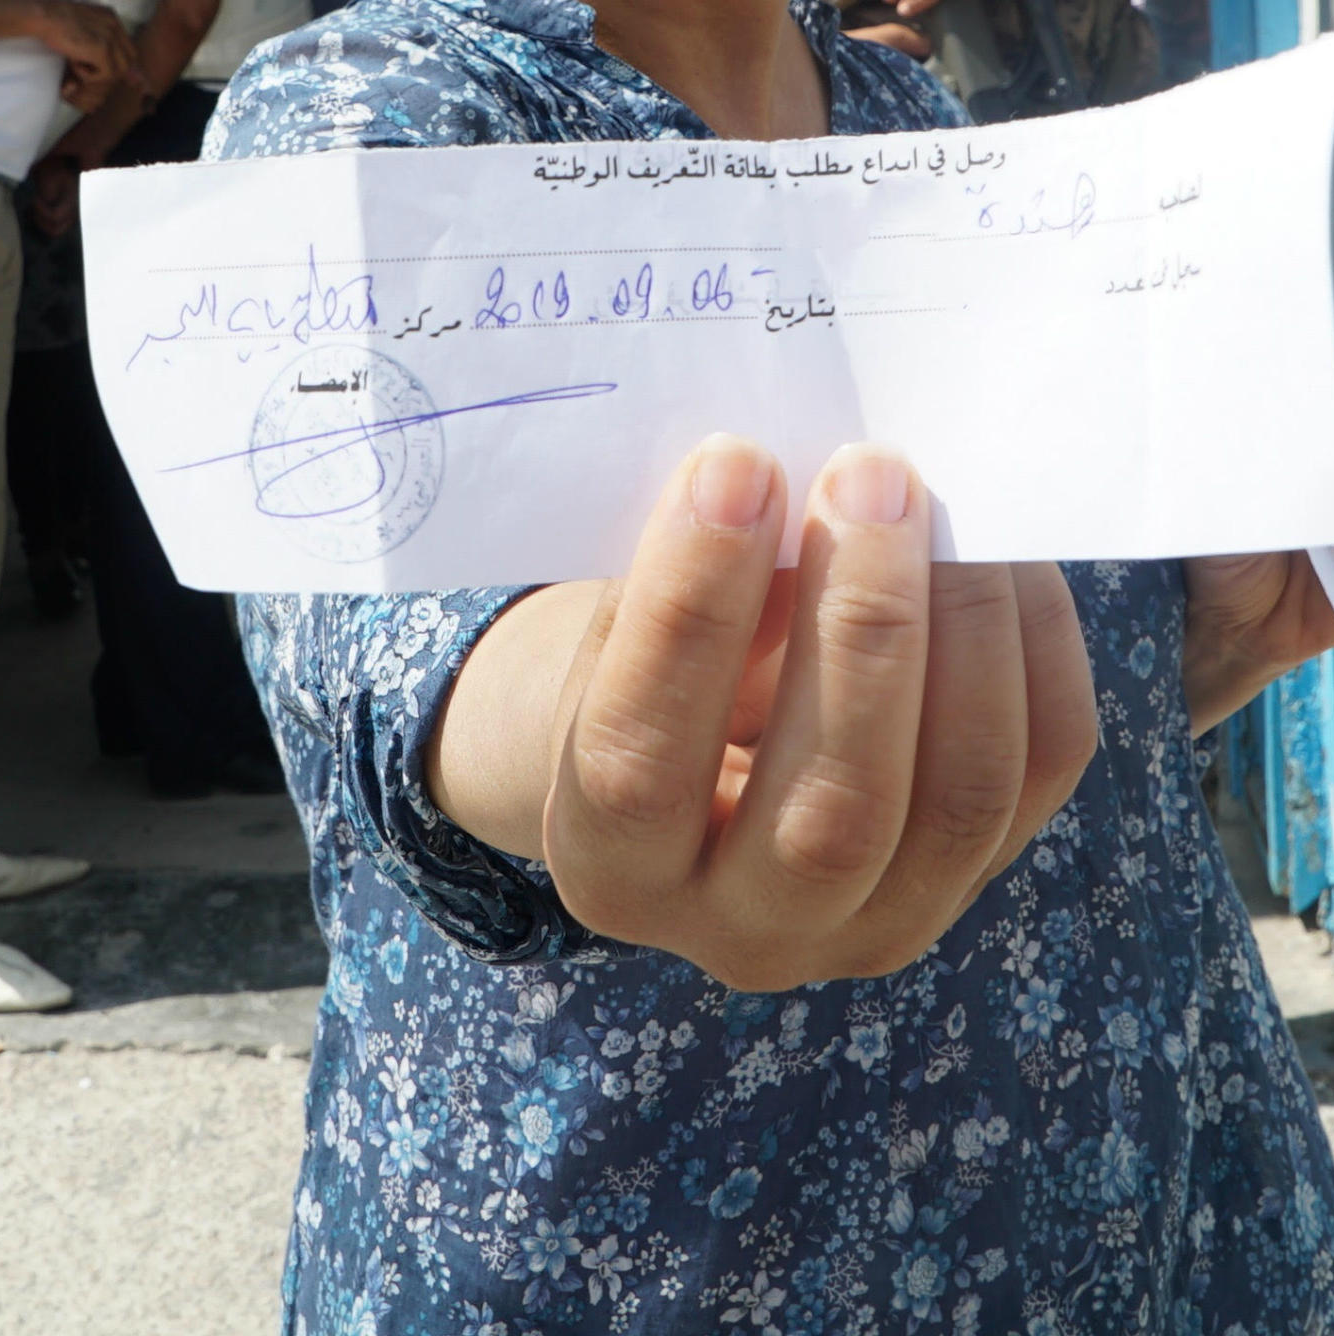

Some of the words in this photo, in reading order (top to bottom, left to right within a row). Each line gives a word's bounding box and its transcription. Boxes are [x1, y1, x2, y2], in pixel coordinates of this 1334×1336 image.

[725, 154, 777, 189] بطاقة
[786, 153, 854, 187] مطلب
[927, 143, 947, 176] في
[955, 143, 1006, 175] وصل
[392, 306, 463, 339] مركز
[764, 293, 836, 332] بتاريخ
